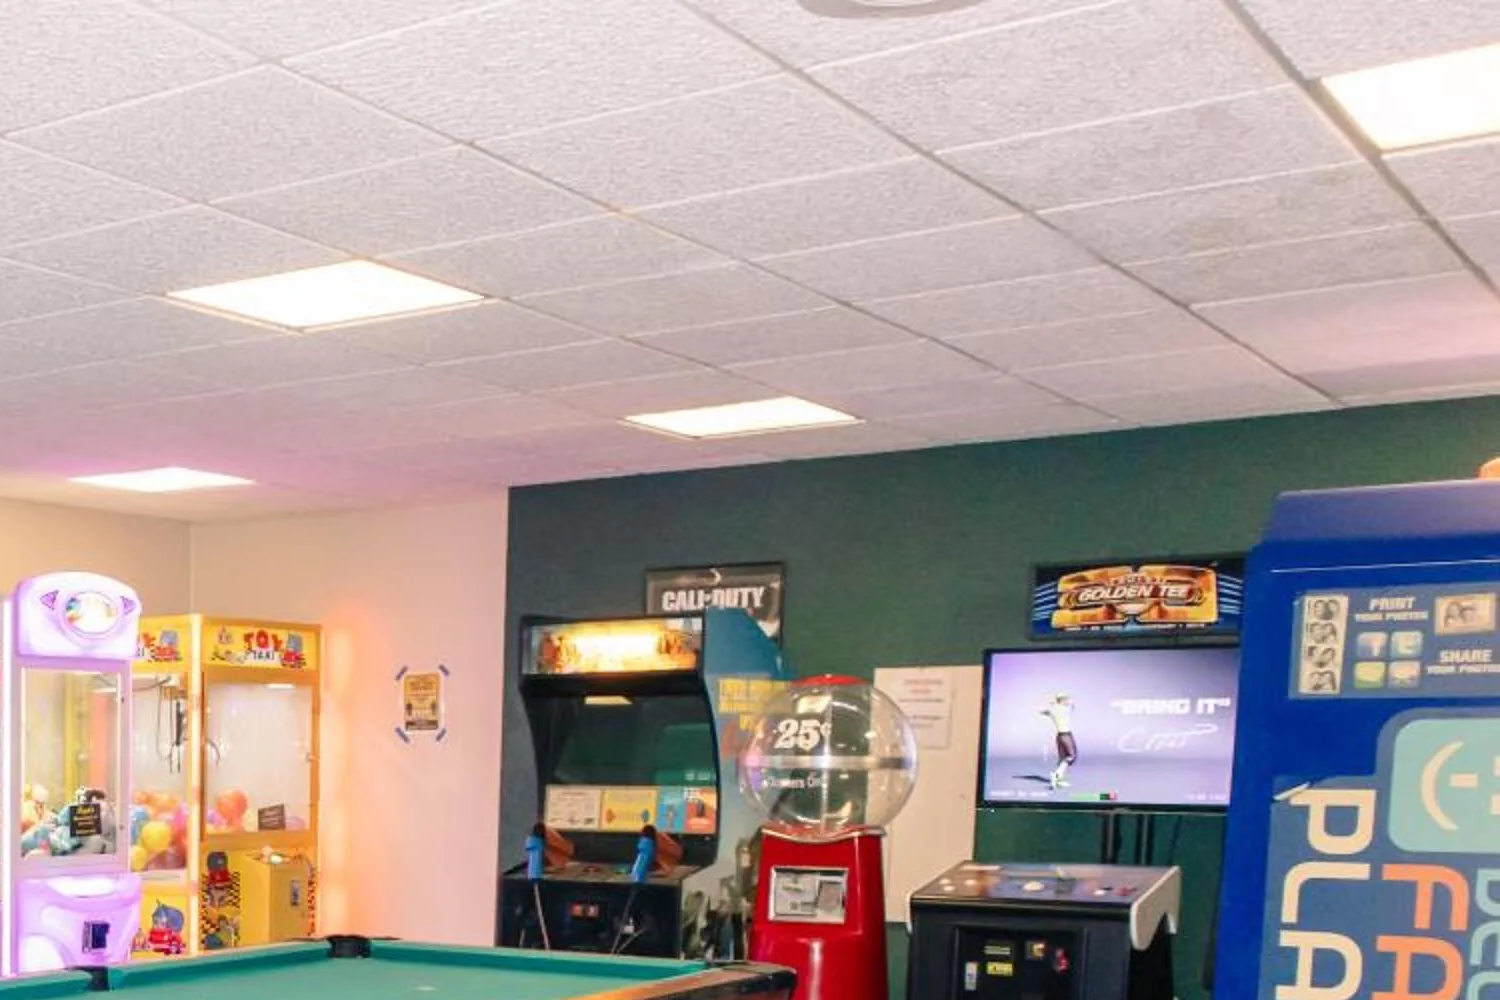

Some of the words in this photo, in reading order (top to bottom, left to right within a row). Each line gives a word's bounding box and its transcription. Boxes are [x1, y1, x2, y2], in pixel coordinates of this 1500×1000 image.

[662, 588, 705, 612] CALL
[712, 586, 765, 610] DUTY
[1078, 584, 1153, 602] GOLDEN
[1159, 585, 1191, 598] TEE
[1440, 648, 1493, 664] SHARE
